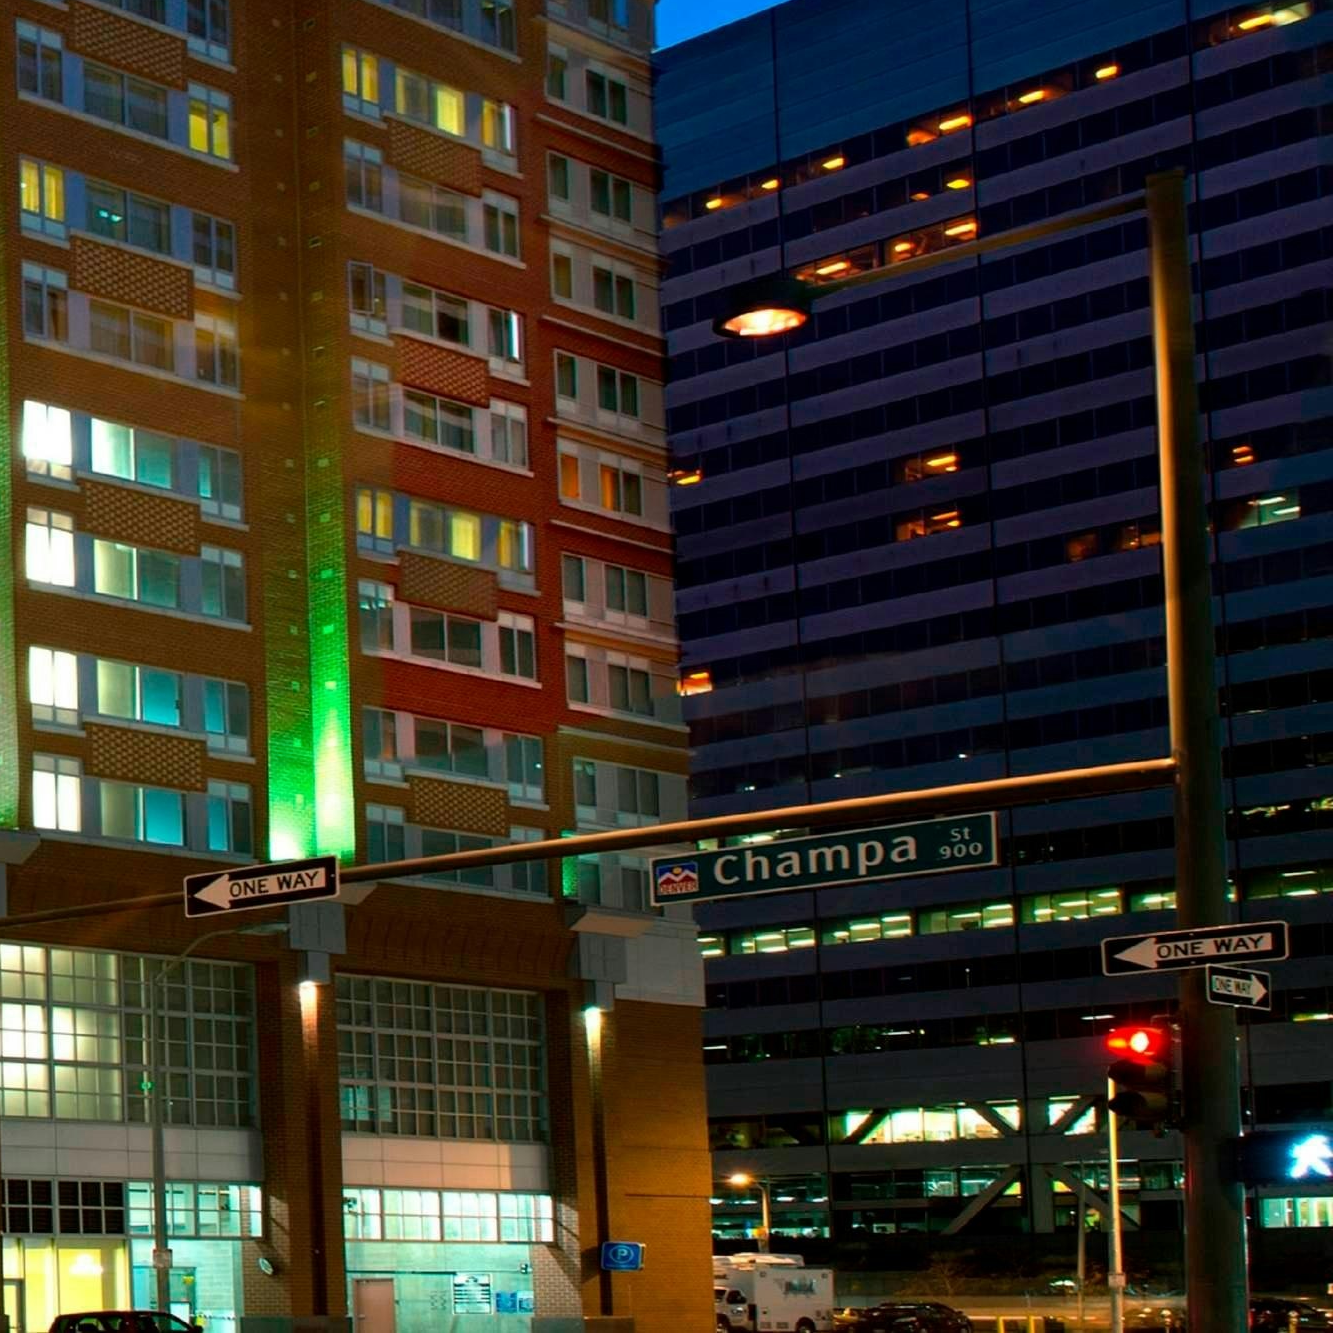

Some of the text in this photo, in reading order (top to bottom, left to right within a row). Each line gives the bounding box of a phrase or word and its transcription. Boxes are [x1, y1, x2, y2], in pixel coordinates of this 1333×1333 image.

[949, 826, 971, 843] St
[713, 834, 917, 885] Champa
[939, 841, 983, 860] 900
[229, 871, 319, 897] ONE WAY
[1156, 935, 1264, 958] ONE WAY
[1214, 977, 1252, 995] ONE WAY
[616, 1248, 629, 1260] P
